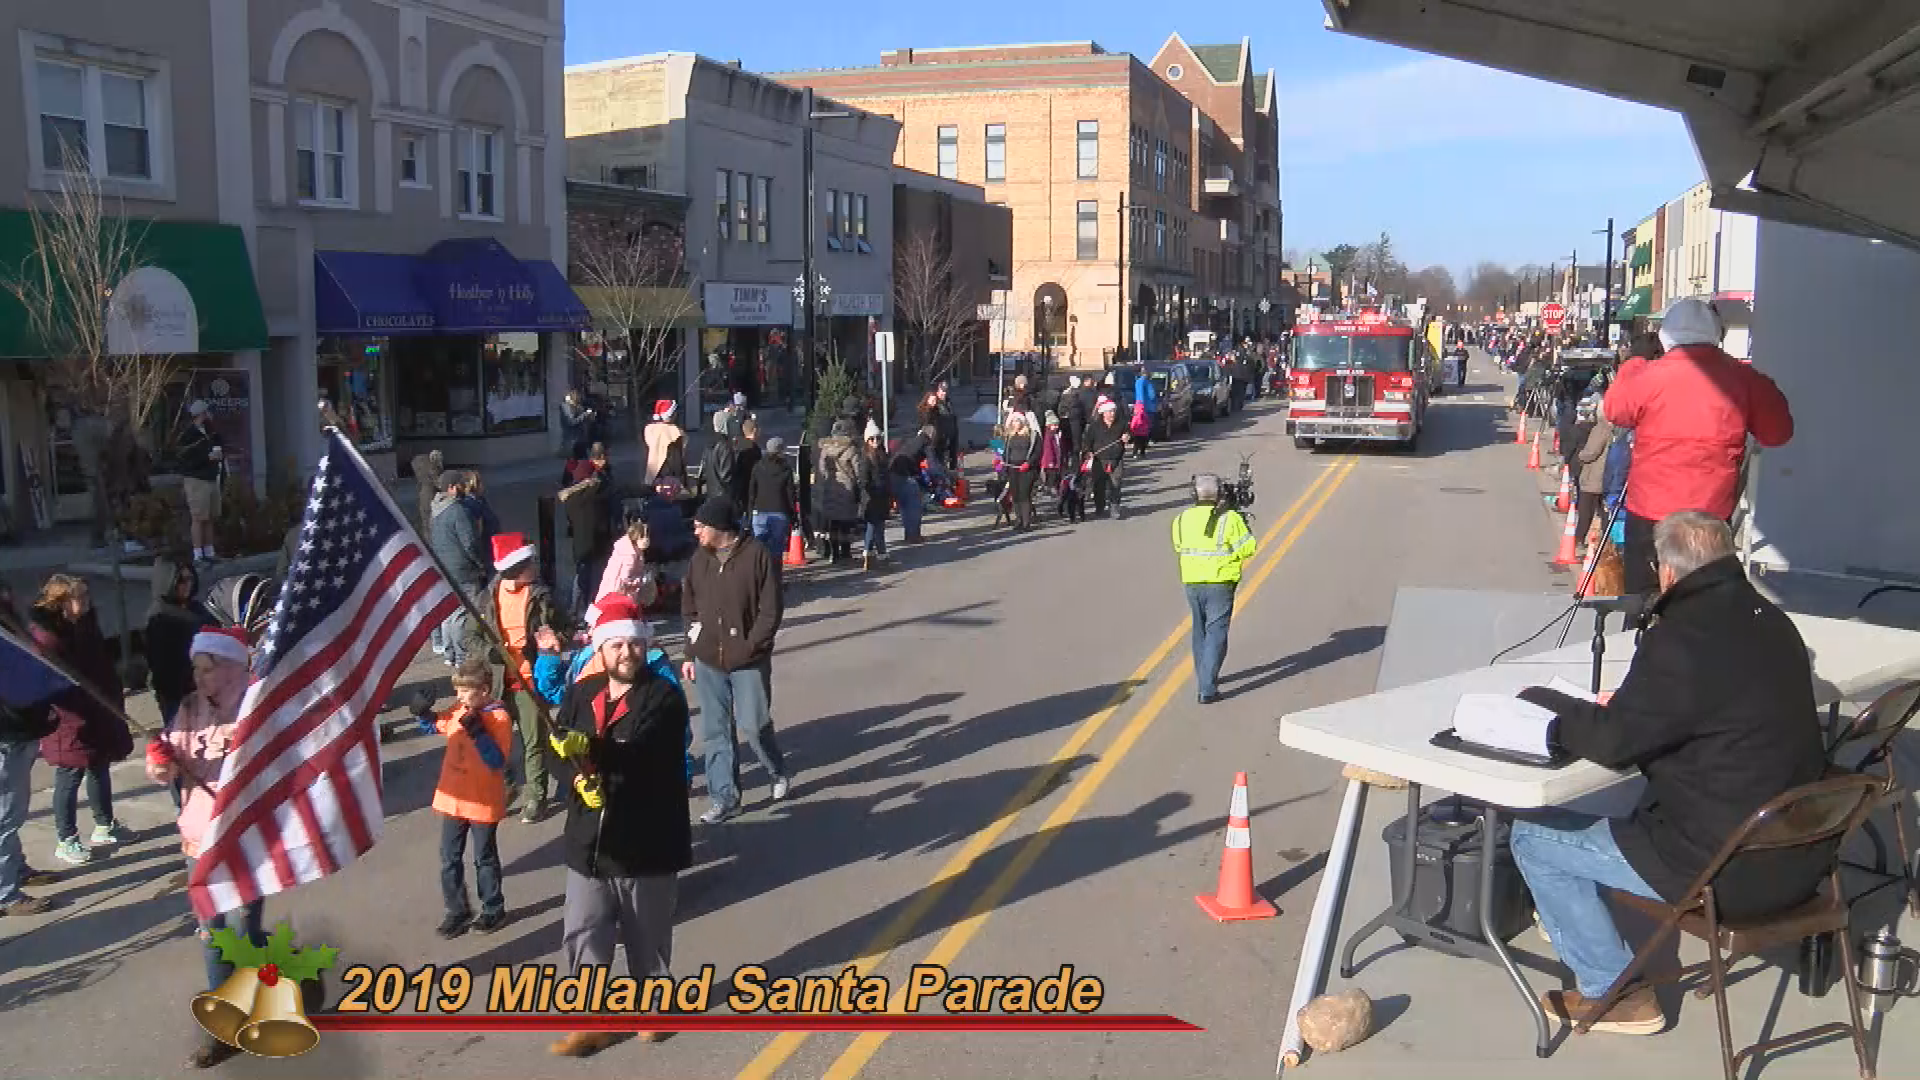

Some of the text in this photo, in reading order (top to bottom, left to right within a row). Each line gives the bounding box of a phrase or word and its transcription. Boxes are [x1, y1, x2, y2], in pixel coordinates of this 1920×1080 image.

[733, 287, 768, 302] TIMM'S
[1543, 309, 1564, 319] STOP
[365, 315, 435, 327] CHOCOLATES
